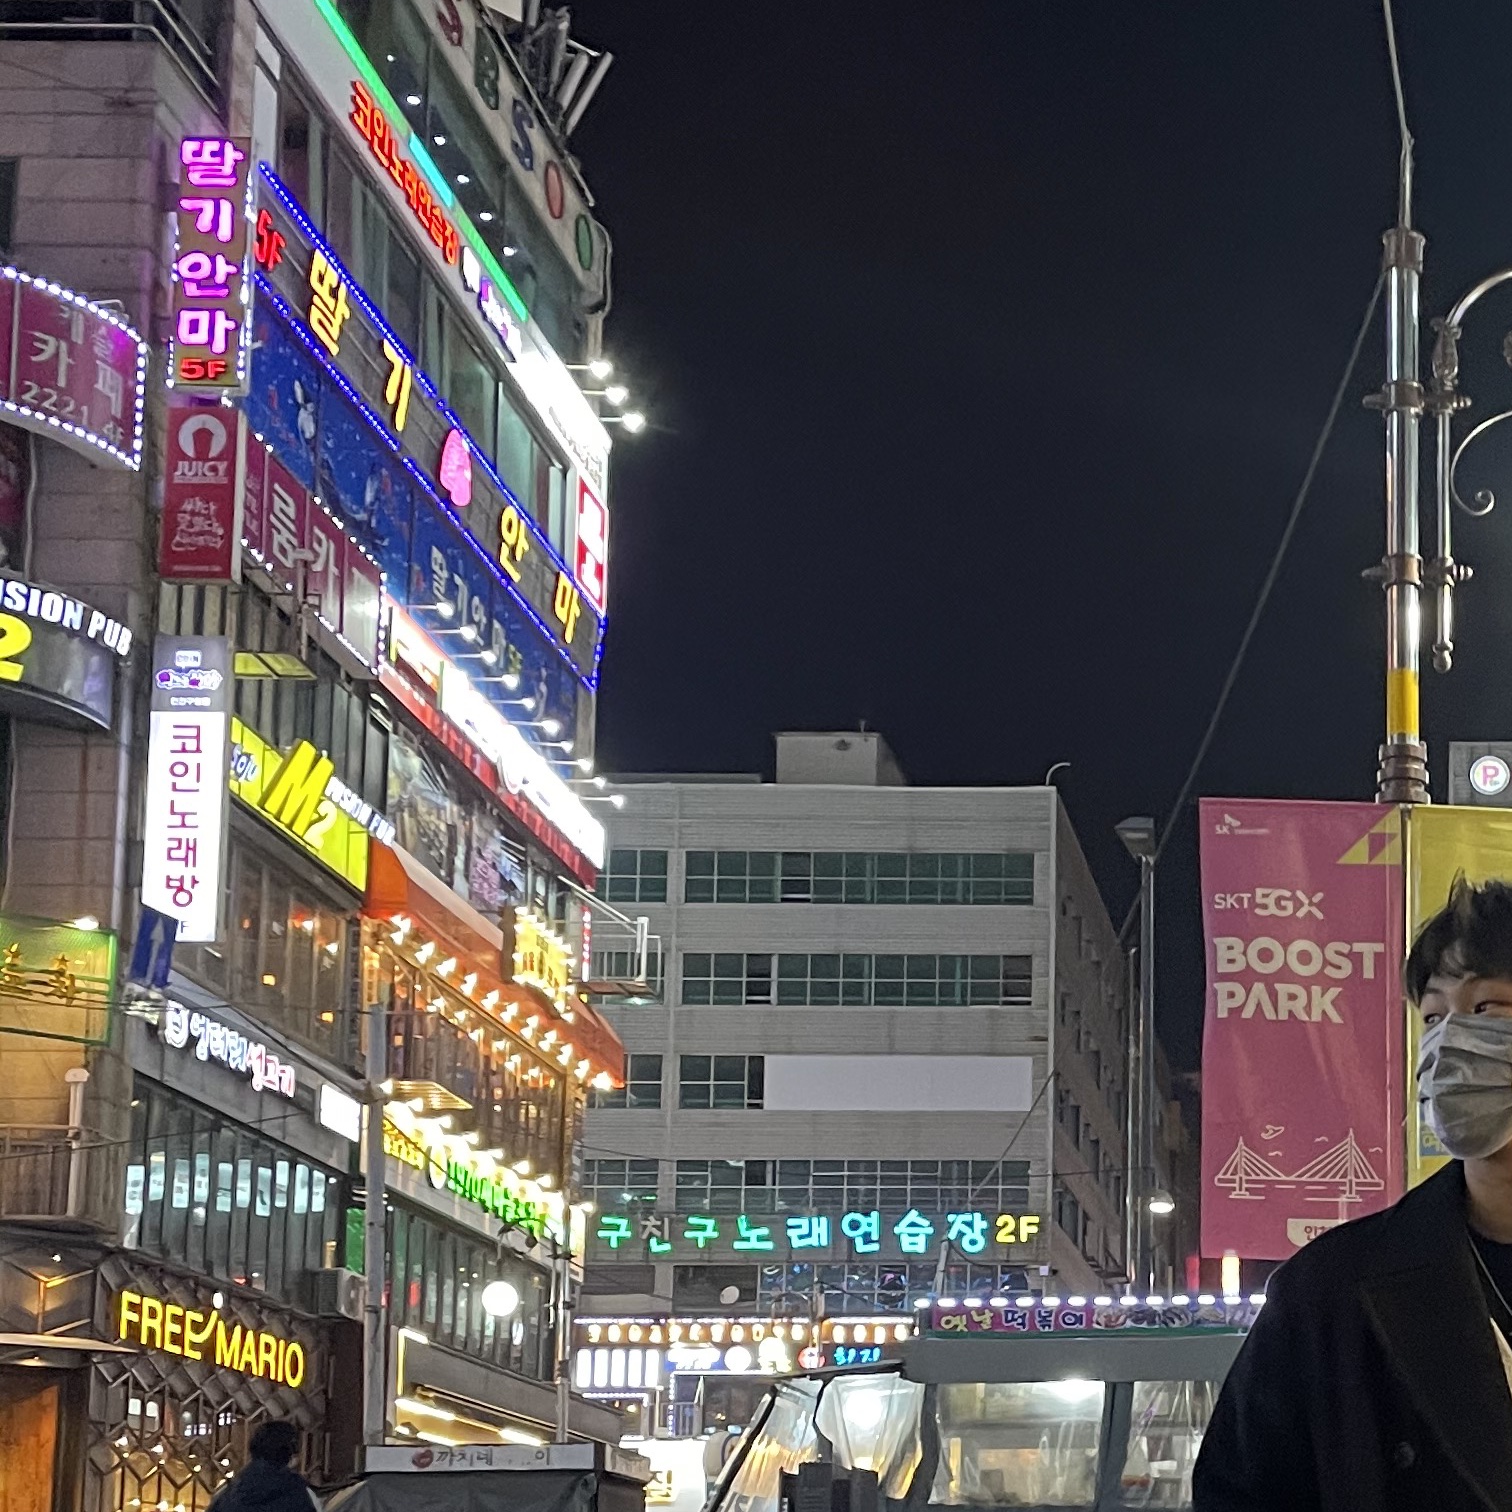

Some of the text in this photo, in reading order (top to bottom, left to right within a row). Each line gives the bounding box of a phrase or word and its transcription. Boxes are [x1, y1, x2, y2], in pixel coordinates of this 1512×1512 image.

[349, 80, 460, 266] 코인노래연습장
[176, 138, 246, 355] 딸기안마
[180, 358, 227, 379] 5F
[173, 460, 228, 476] JUICY
[0, 578, 133, 656] SION PUB
[164, 724, 203, 908] 코인노래방
[1214, 887, 1325, 921] SKT 5GX
[1213, 936, 1385, 980] BOOST
[1213, 981, 1345, 1024] PARK
[995, 1214, 1041, 1244] 2F
[119, 1289, 304, 1388] FREE MARIO
[940, 1308, 1086, 1332] 옛날 떡볶이
